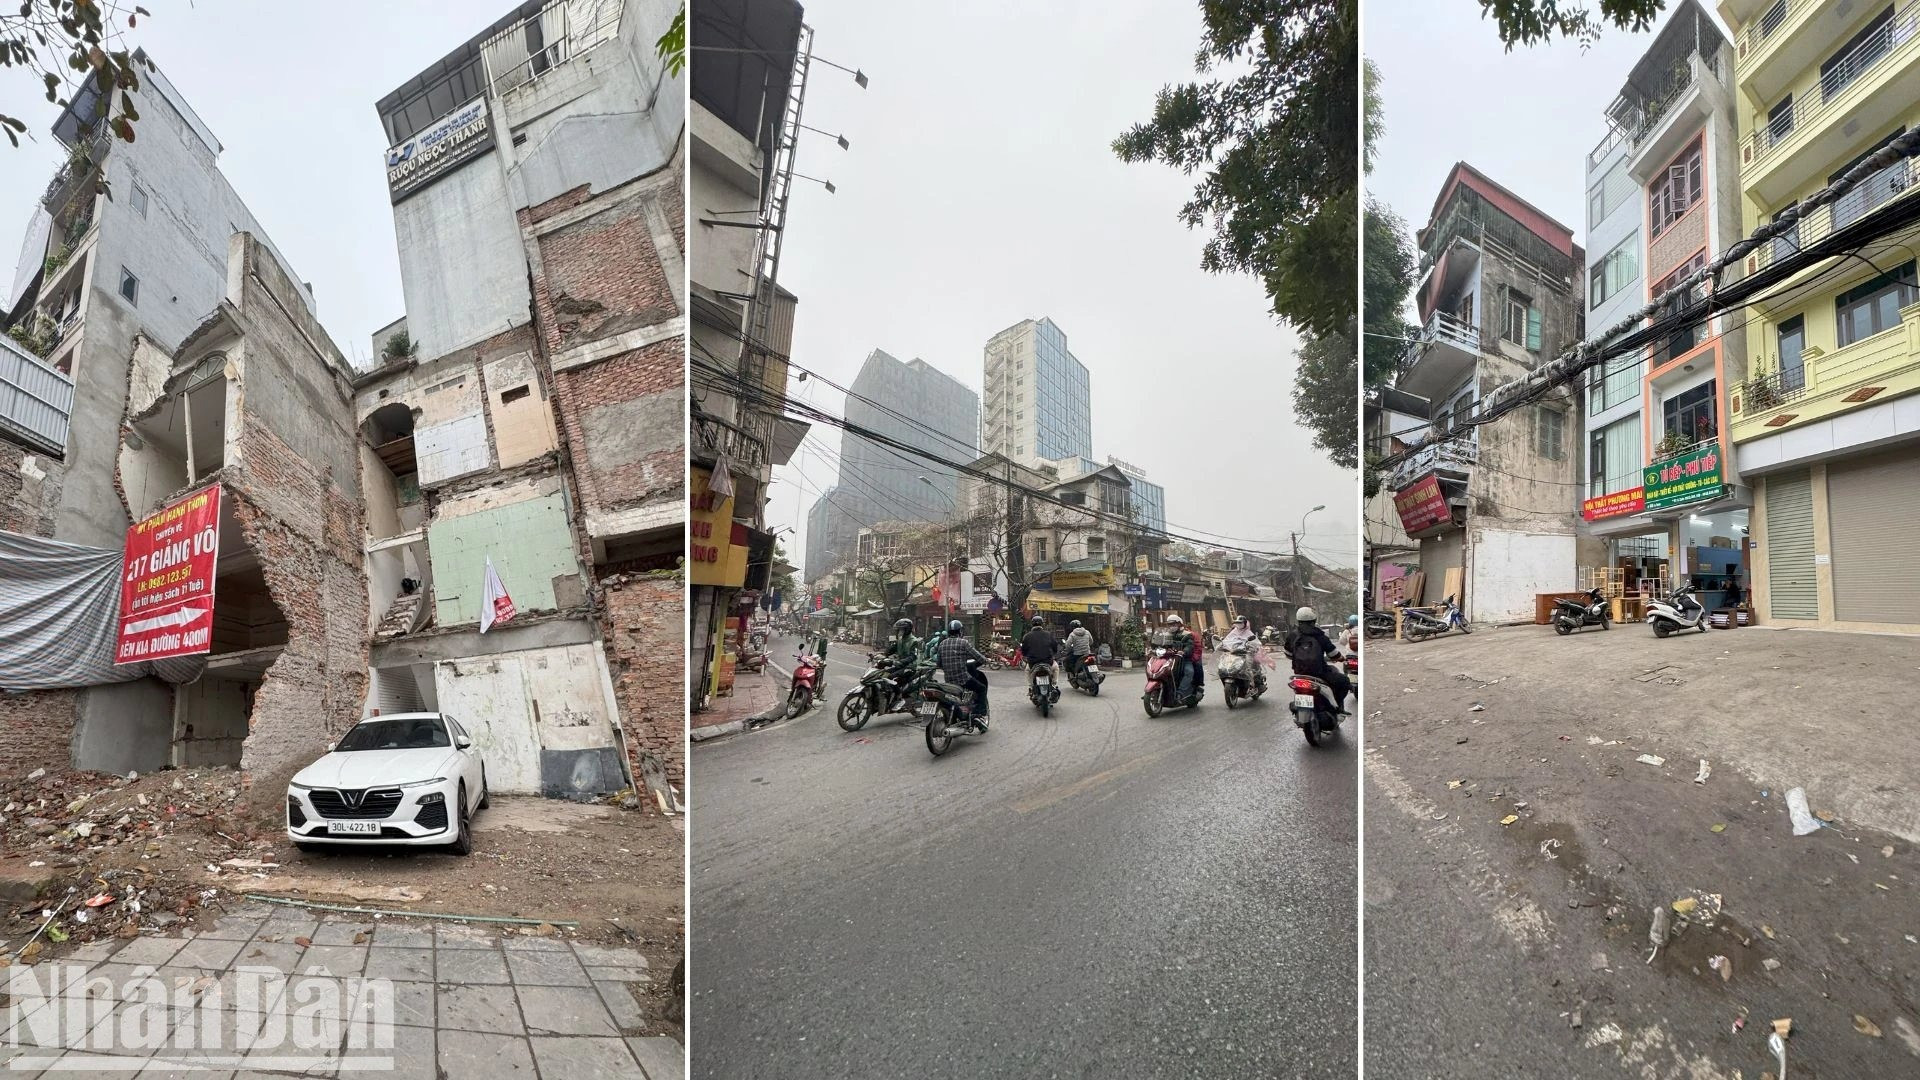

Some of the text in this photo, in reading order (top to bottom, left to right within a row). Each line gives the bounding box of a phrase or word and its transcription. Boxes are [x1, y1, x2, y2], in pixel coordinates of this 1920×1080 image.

[418, 142, 447, 166] NGỌC
[448, 118, 487, 147] THANH
[1669, 460, 1682, 481] BẾP
[1686, 456, 1699, 477] PHÚ
[1700, 450, 1717, 472] TIẾP
[1595, 497, 1606, 508] THẤT
[1608, 494, 1630, 506] PHƯƠNG
[1631, 490, 1643, 500] MAI
[150, 540, 191, 573] GIẢNG
[194, 525, 216, 556] VÕ
[165, 586, 180, 601] sách
[120, 638, 136, 658] BÊN
[151, 633, 181, 653] ĐƯỜNG
[183, 626, 209, 648] 400M
[332, 822, 376, 832] 30L-422.18
